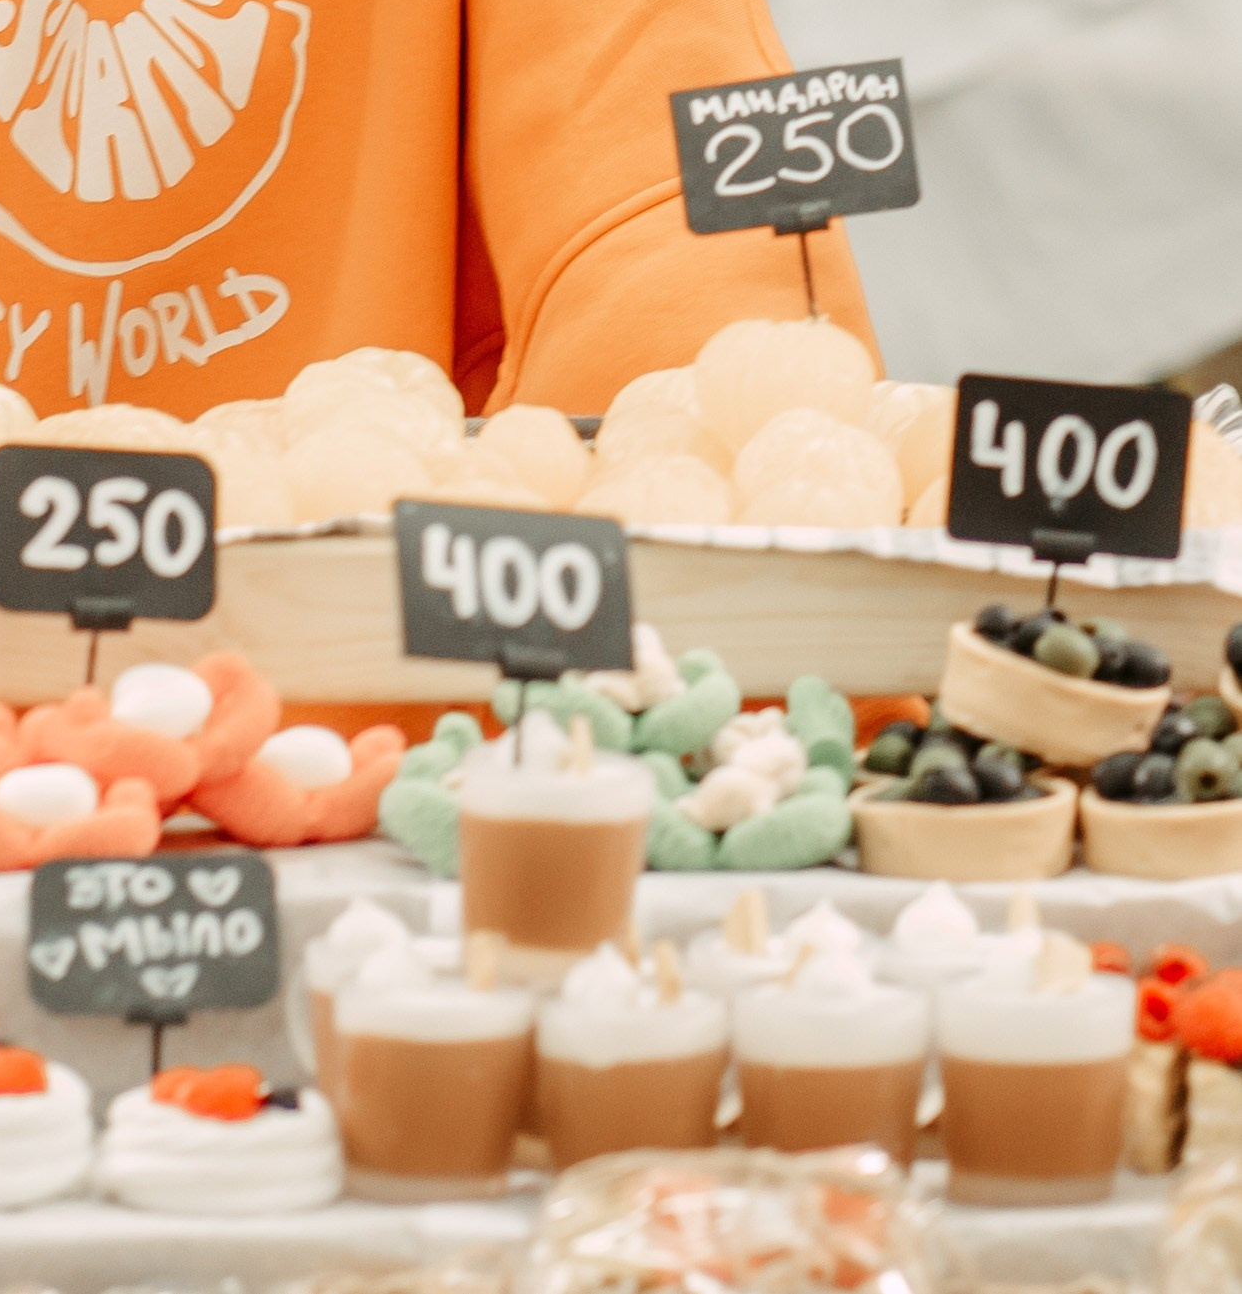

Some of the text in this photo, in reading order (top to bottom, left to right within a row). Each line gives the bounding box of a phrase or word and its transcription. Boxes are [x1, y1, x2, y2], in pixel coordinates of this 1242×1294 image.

[704, 103, 903, 197] 250
[68, 268, 290, 409] WORLD
[969, 398, 1158, 510] 400
[19, 474, 207, 579] 250
[421, 522, 603, 631] 400
[65, 861, 175, 911] ЭТО
[78, 908, 265, 971] МЫЛО
